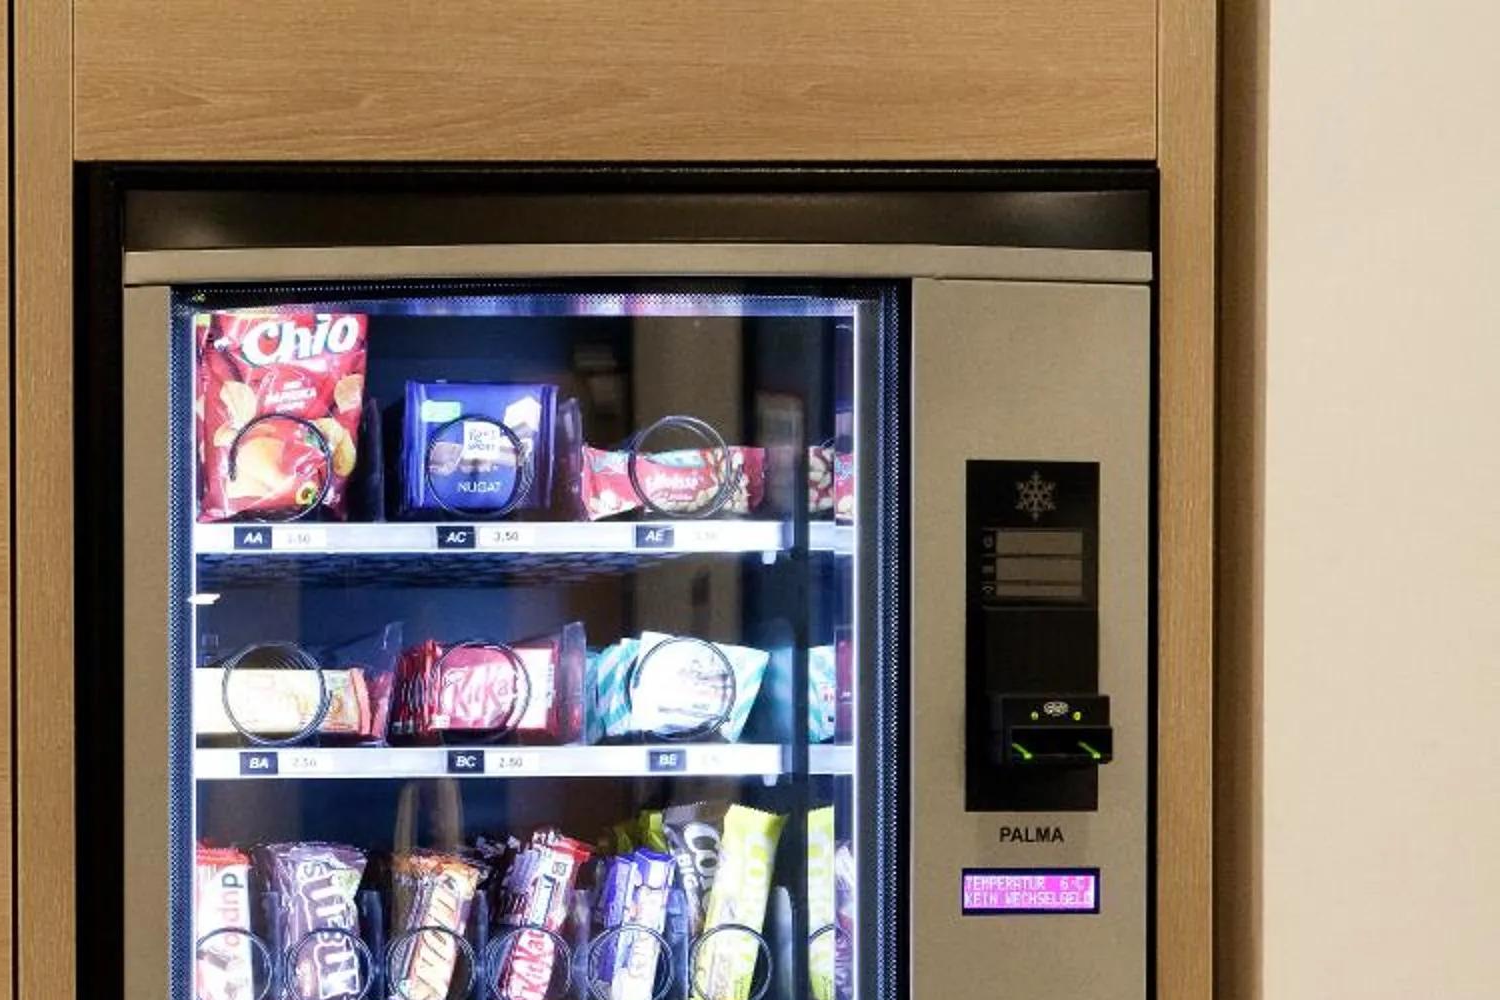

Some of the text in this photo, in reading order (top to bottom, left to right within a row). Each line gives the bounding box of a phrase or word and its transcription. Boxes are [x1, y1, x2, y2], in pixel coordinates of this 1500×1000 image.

[242, 314, 359, 366] Chio
[244, 532, 263, 543] AA
[446, 531, 467, 543] AC
[645, 531, 663, 542] AE
[250, 757, 269, 769] BA
[456, 755, 476, 768] BC
[999, 826, 1065, 843] PALMA
